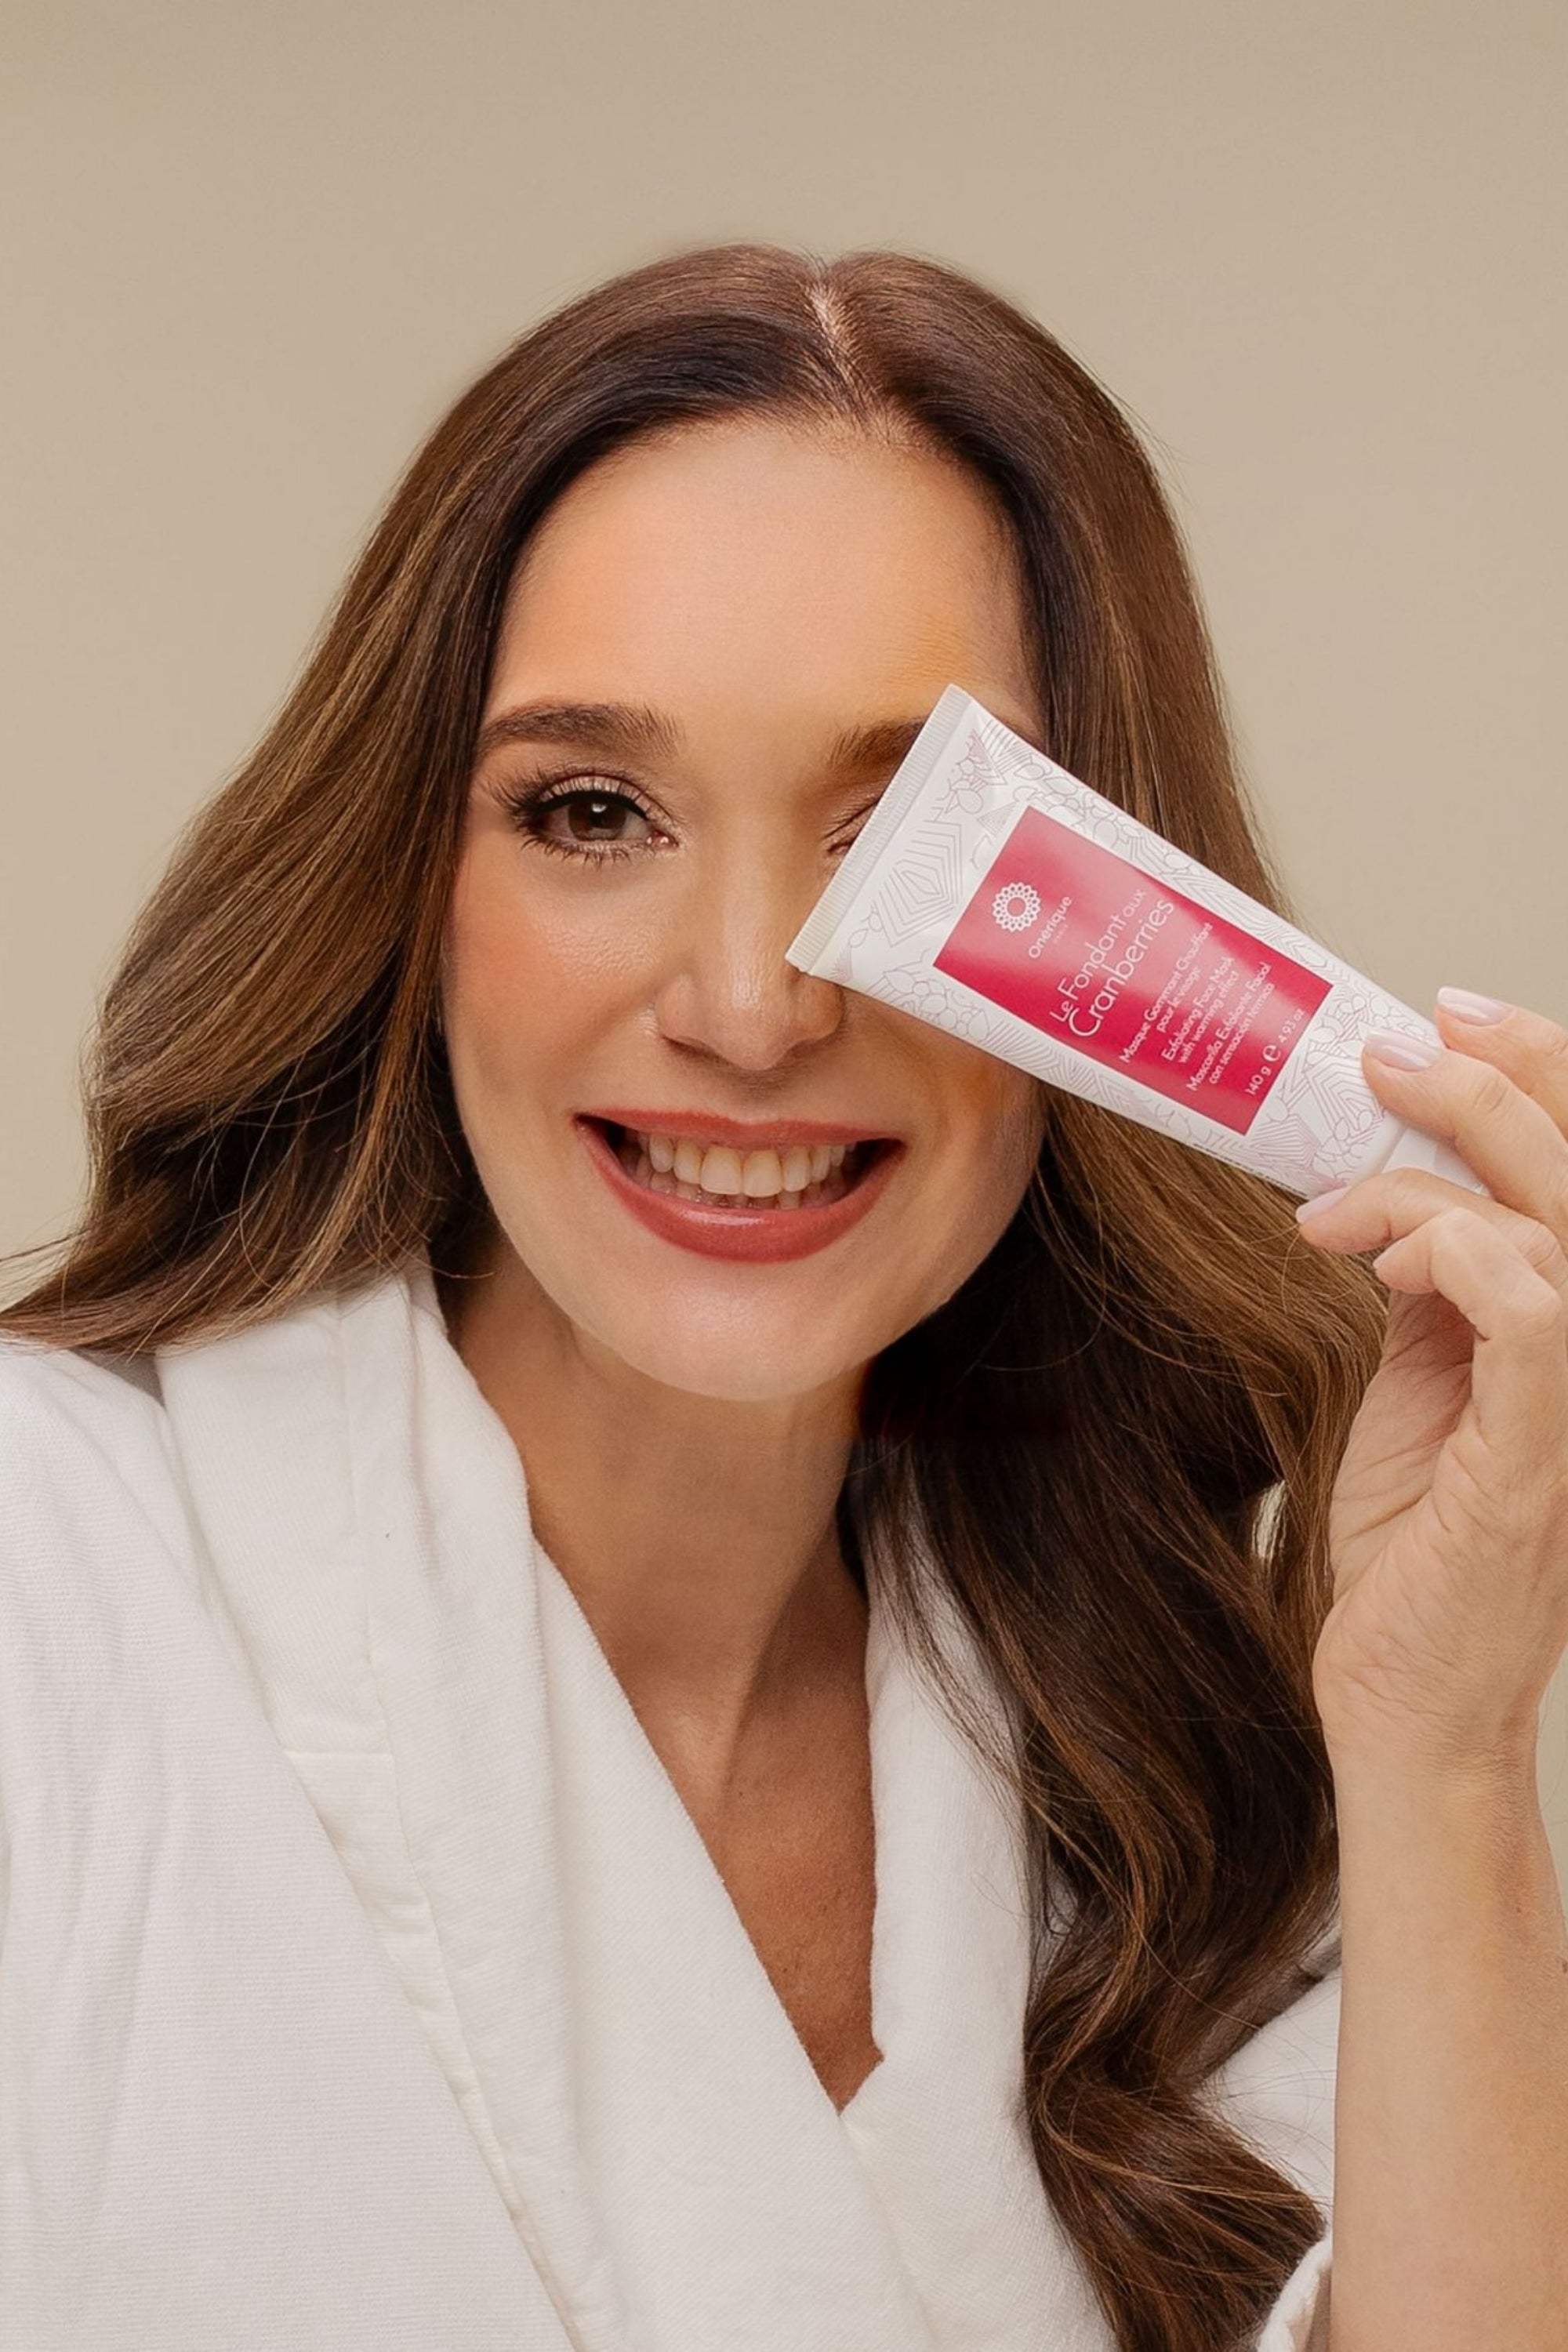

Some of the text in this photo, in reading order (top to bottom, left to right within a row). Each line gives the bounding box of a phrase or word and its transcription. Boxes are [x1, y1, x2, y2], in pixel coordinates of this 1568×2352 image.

[1122, 888, 1146, 916] aux
[1057, 915, 1125, 1000] Fondant
[1068, 900, 1174, 1036] Cranberries
[1119, 923, 1212, 1062] Masque Gommant Chauffant
[1156, 966, 1200, 1033] pour le visage
[1049, 1000, 1073, 1022] Le
[1160, 954, 1235, 1060] Exfoliating Face Mask
[1178, 970, 1239, 1062] with warming effect
[1185, 961, 1271, 1091] Mascarilla Exfoliante Facial
[1209, 1065, 1223, 1083] con
[1244, 1074, 1263, 1094] 140
[1261, 1065, 1270, 1075] g
[1293, 1008, 1304, 1021] oz
